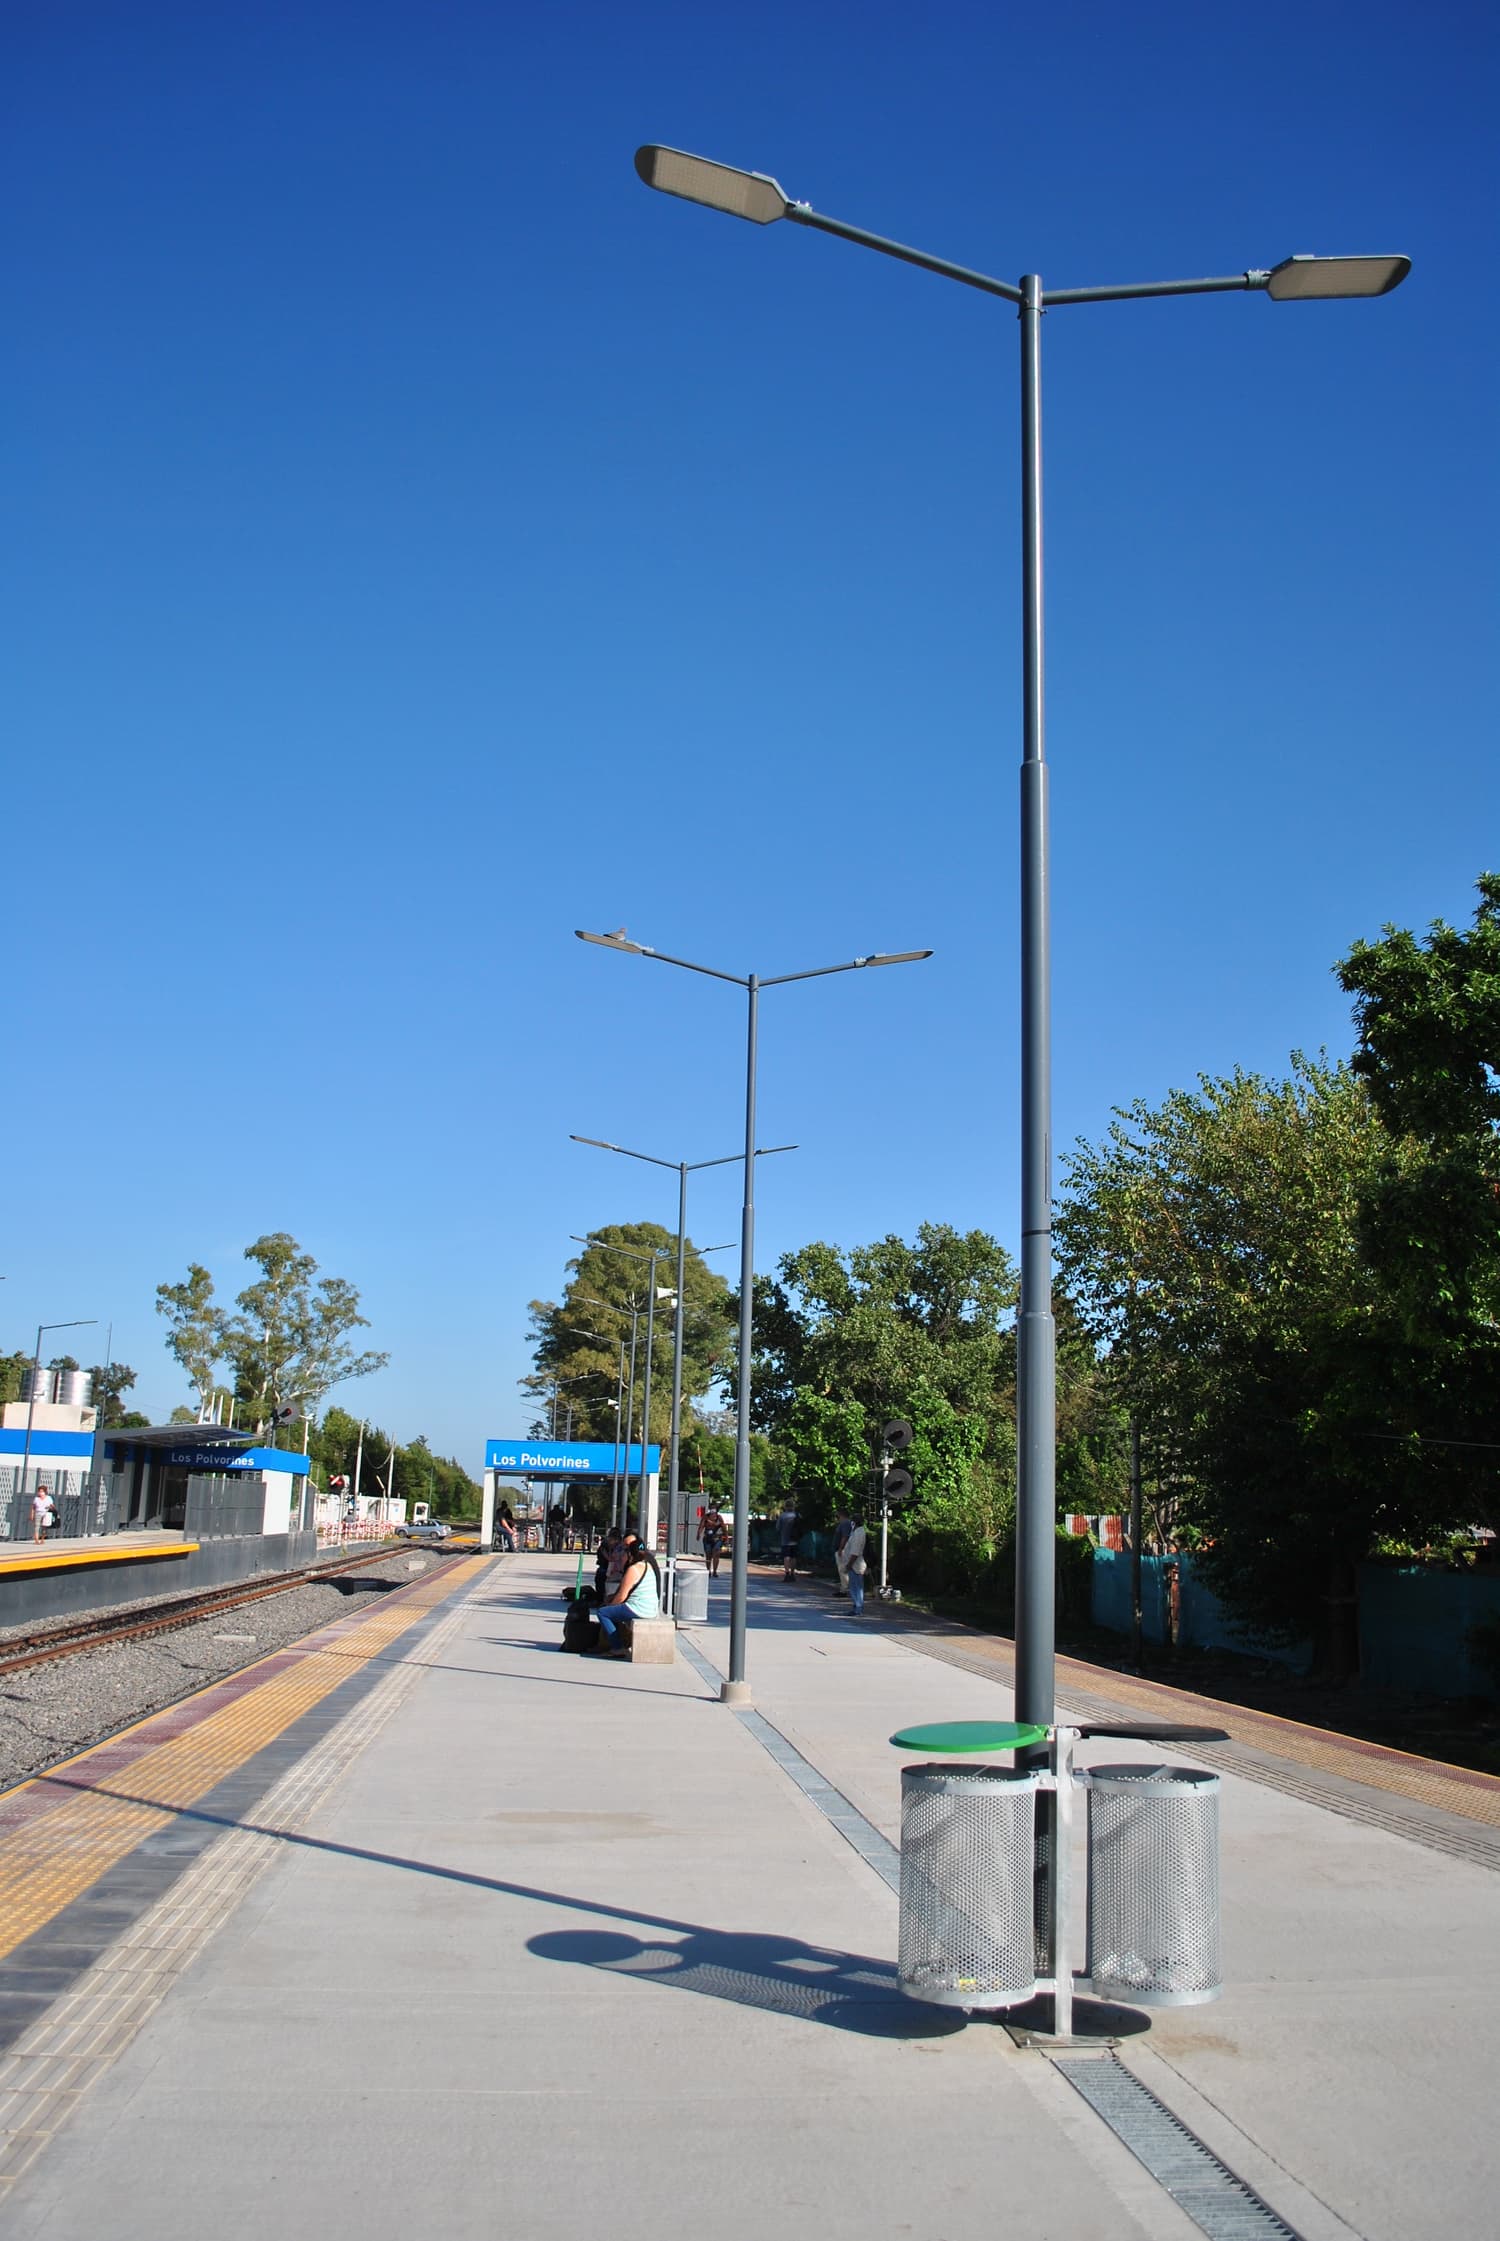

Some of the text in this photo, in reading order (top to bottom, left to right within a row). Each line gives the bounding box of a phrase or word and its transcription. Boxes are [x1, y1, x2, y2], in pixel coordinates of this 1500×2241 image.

[171, 1453, 254, 1466] Los Polvorines
[493, 1453, 589, 1467] Los Polvorines
